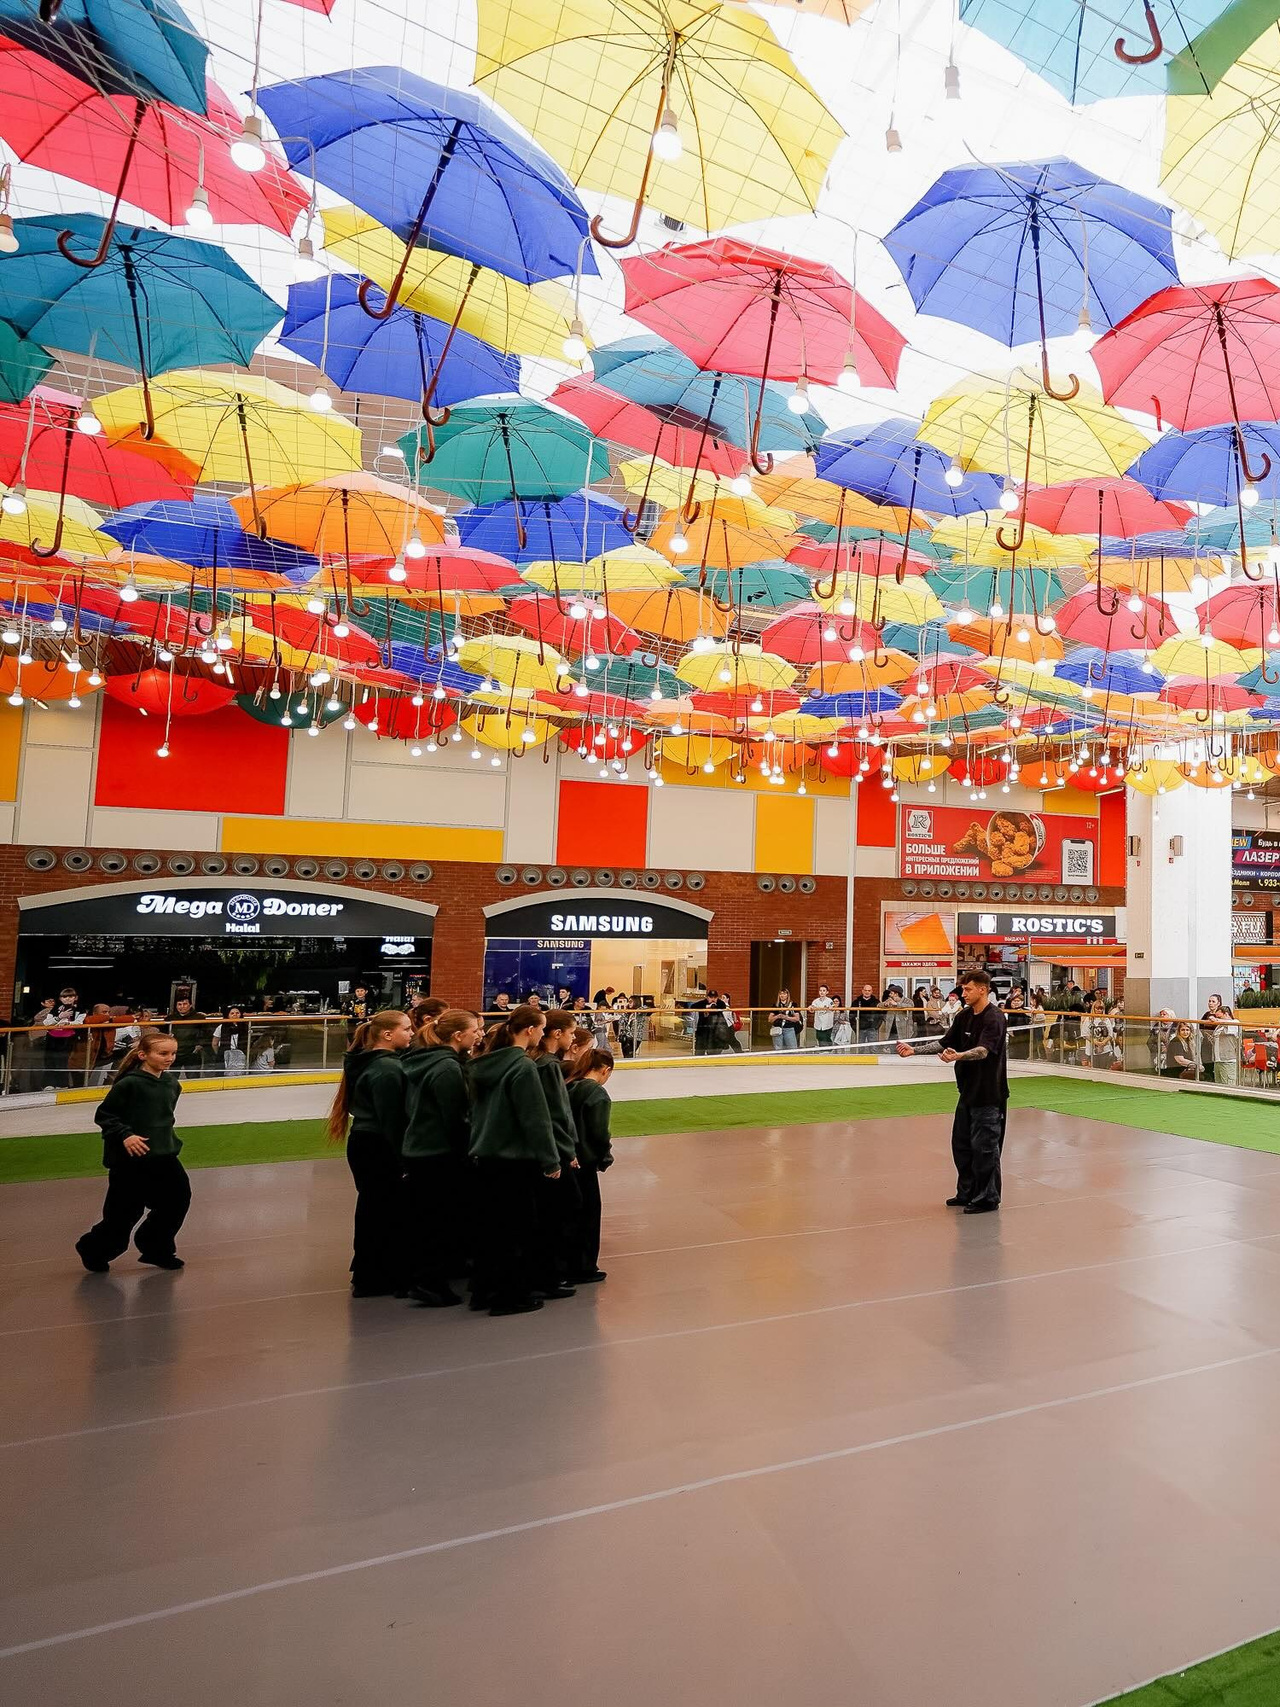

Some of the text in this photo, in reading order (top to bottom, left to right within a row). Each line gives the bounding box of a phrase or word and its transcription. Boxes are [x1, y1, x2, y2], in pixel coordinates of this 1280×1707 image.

[1086, 821, 1095, 829] 12+
[1232, 838, 1248, 847] EW
[1258, 839, 1273, 848] Будь
[906, 843, 946, 855] БОЛЬШЕ
[905, 864, 980, 877] В ПРИЛОЖЕНИИ
[136, 895, 344, 919] Mega Doner
[234, 902, 255, 914] MD
[225, 923, 260, 933] Halal
[551, 914, 653, 932] SAMSUNG
[1011, 917, 1104, 933] ROSTIC'S
[537, 940, 584, 948] SAMSUNG
